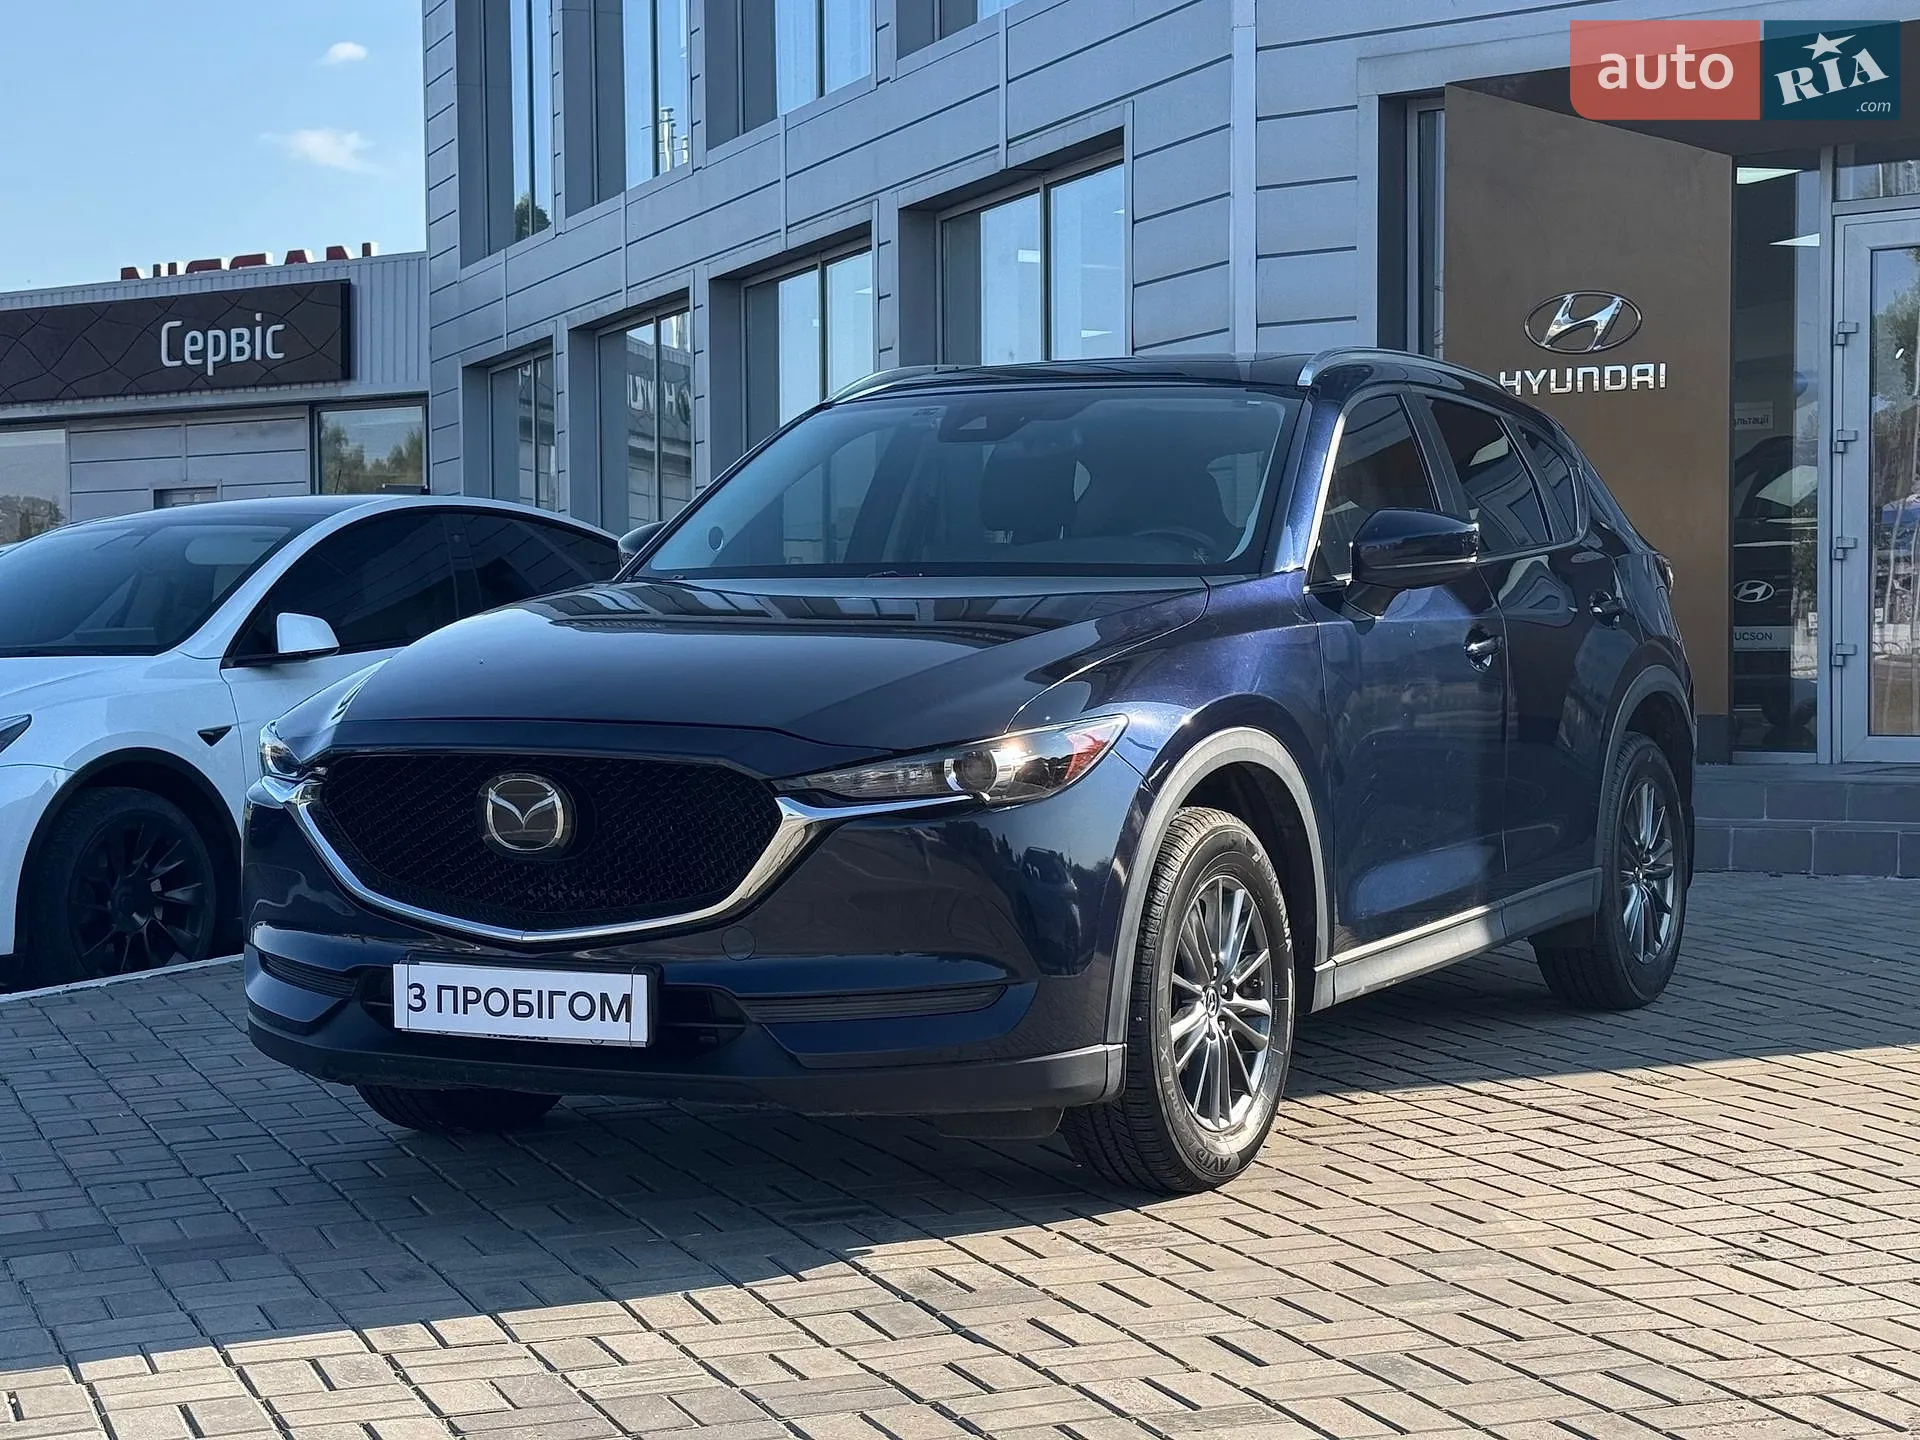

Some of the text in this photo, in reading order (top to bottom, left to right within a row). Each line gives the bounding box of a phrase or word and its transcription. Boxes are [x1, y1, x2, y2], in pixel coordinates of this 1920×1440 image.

[160, 312, 286, 377] Сервіс
[1499, 362, 1667, 396] HYUNDAI
[1735, 414, 1769, 427] льтації
[1734, 631, 1773, 641] UCSON
[437, 984, 631, 1023] ПРОБІГОМ
